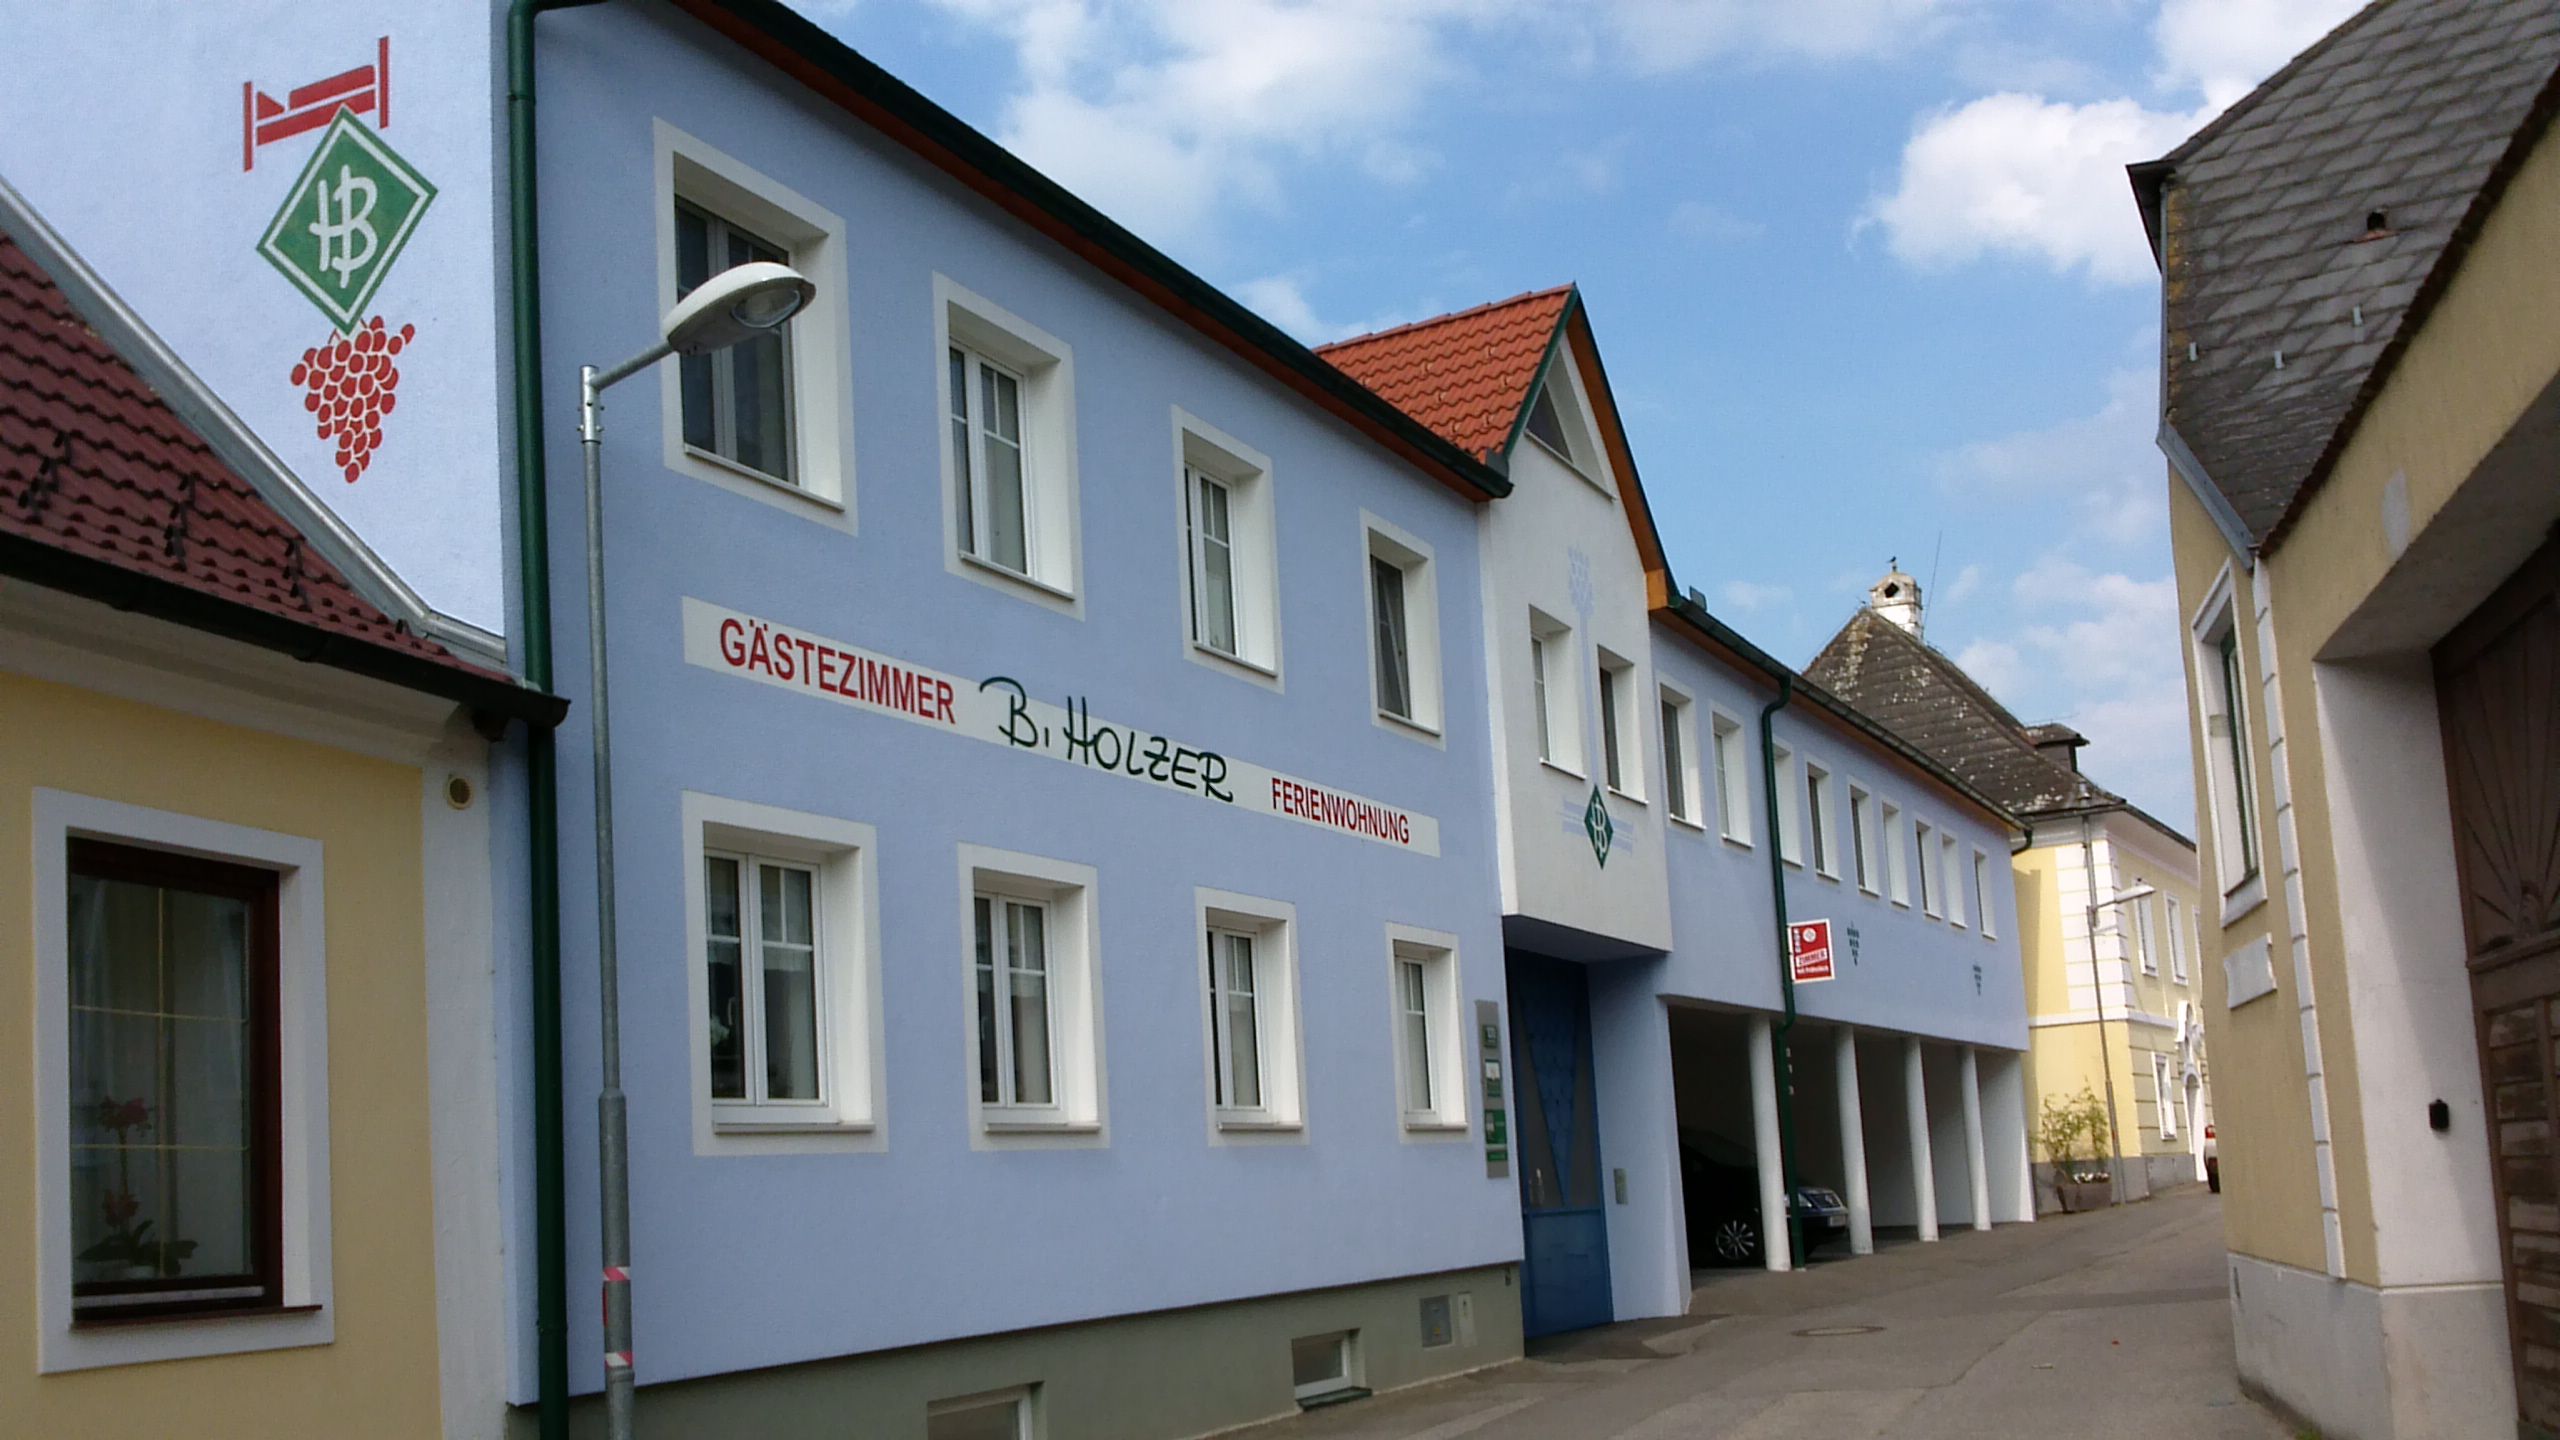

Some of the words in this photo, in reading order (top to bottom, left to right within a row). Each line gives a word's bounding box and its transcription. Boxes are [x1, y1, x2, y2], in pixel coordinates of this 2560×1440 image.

[720, 618, 956, 724] GÄSTEZIMMER
[1062, 696, 1235, 803] HOLZER
[1272, 777, 1410, 845] FERIENWOHNUNG
